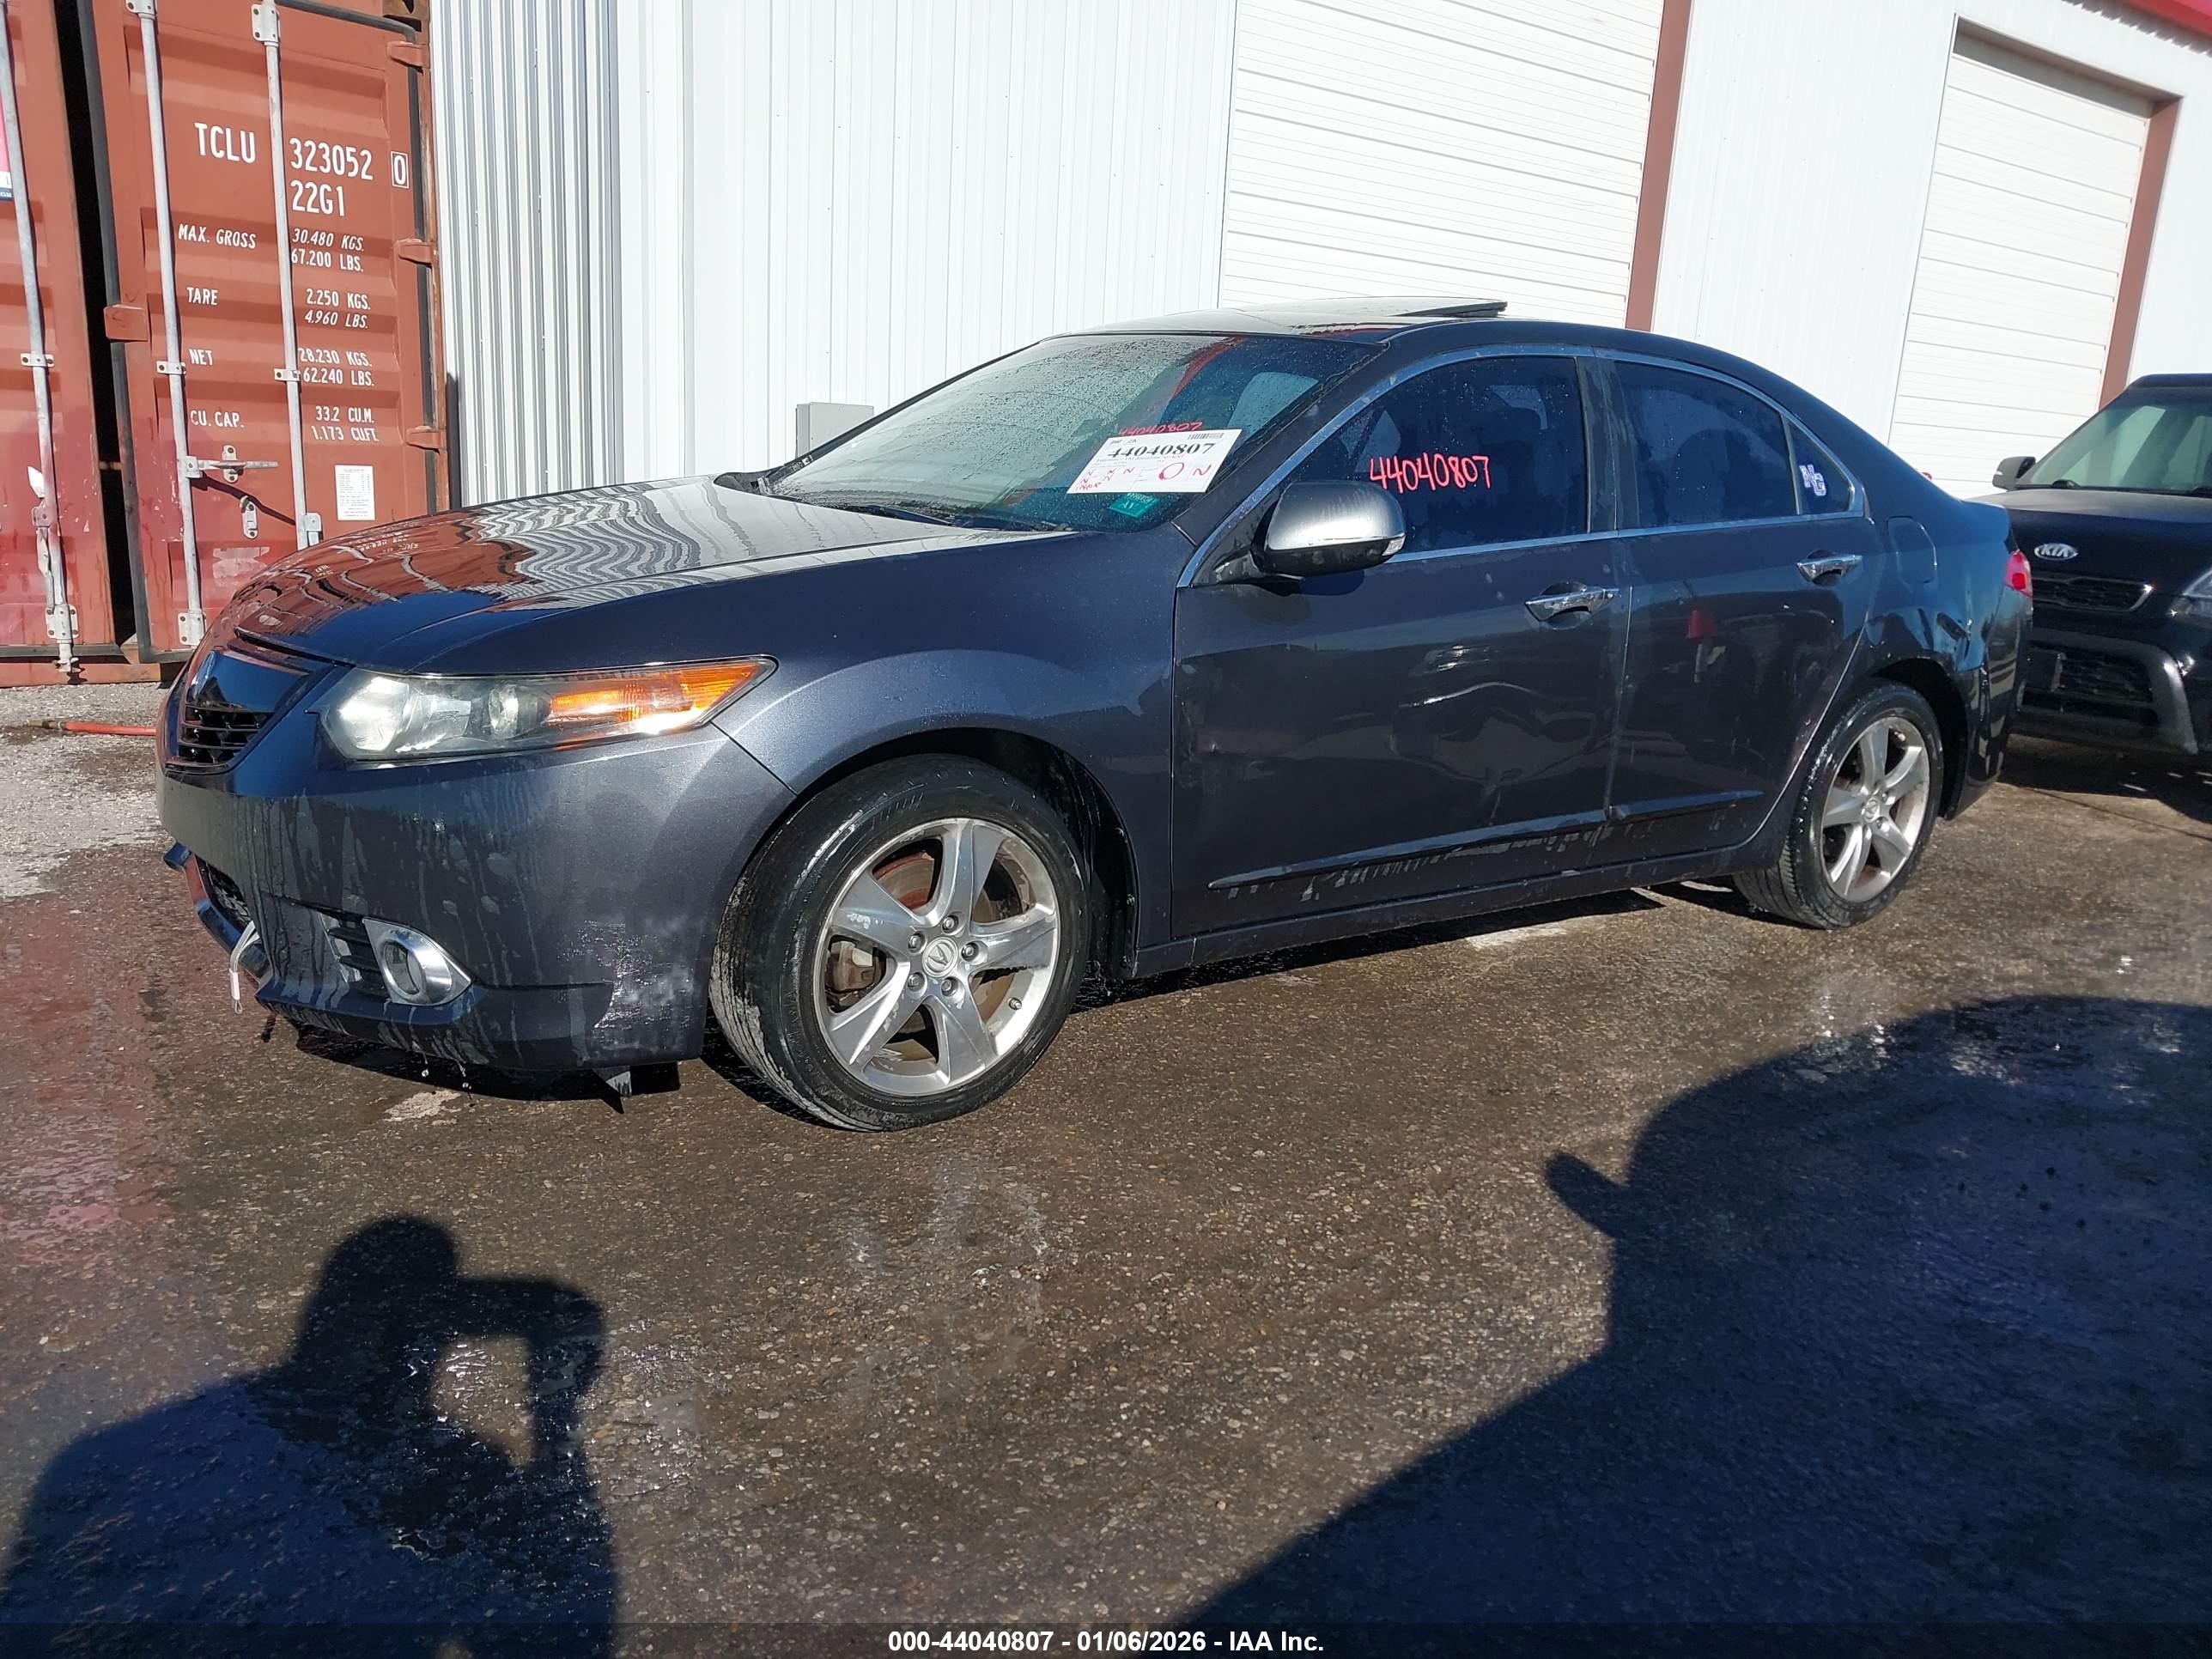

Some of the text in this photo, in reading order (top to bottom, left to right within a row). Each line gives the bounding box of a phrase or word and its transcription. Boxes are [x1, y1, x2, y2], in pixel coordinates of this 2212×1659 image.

[194, 122, 407, 185] TCLU 323052 0
[290, 179, 345, 216] 22G1
[178, 223, 256, 249] MAX. GROSS
[292, 228, 365, 252] 30.480 KGS.
[291, 248, 364, 272] 67.200 LBS.
[186, 287, 218, 306] TARE
[306, 288, 371, 310] 2.250 KGS.
[305, 309, 368, 329] 4.960 LBS.
[189, 349, 213, 366] NET
[298, 347, 373, 368] 28.230 KGS.
[303, 367, 375, 387] 62.240 LBS.
[190, 410, 245, 428] CU. CAP.
[315, 405, 340, 422] 33.2
[311, 425, 343, 441] 1.173
[1108, 441, 1217, 459] 44040807
[1370, 452, 1491, 494] 44040807
[2038, 544, 2071, 558] KIA
